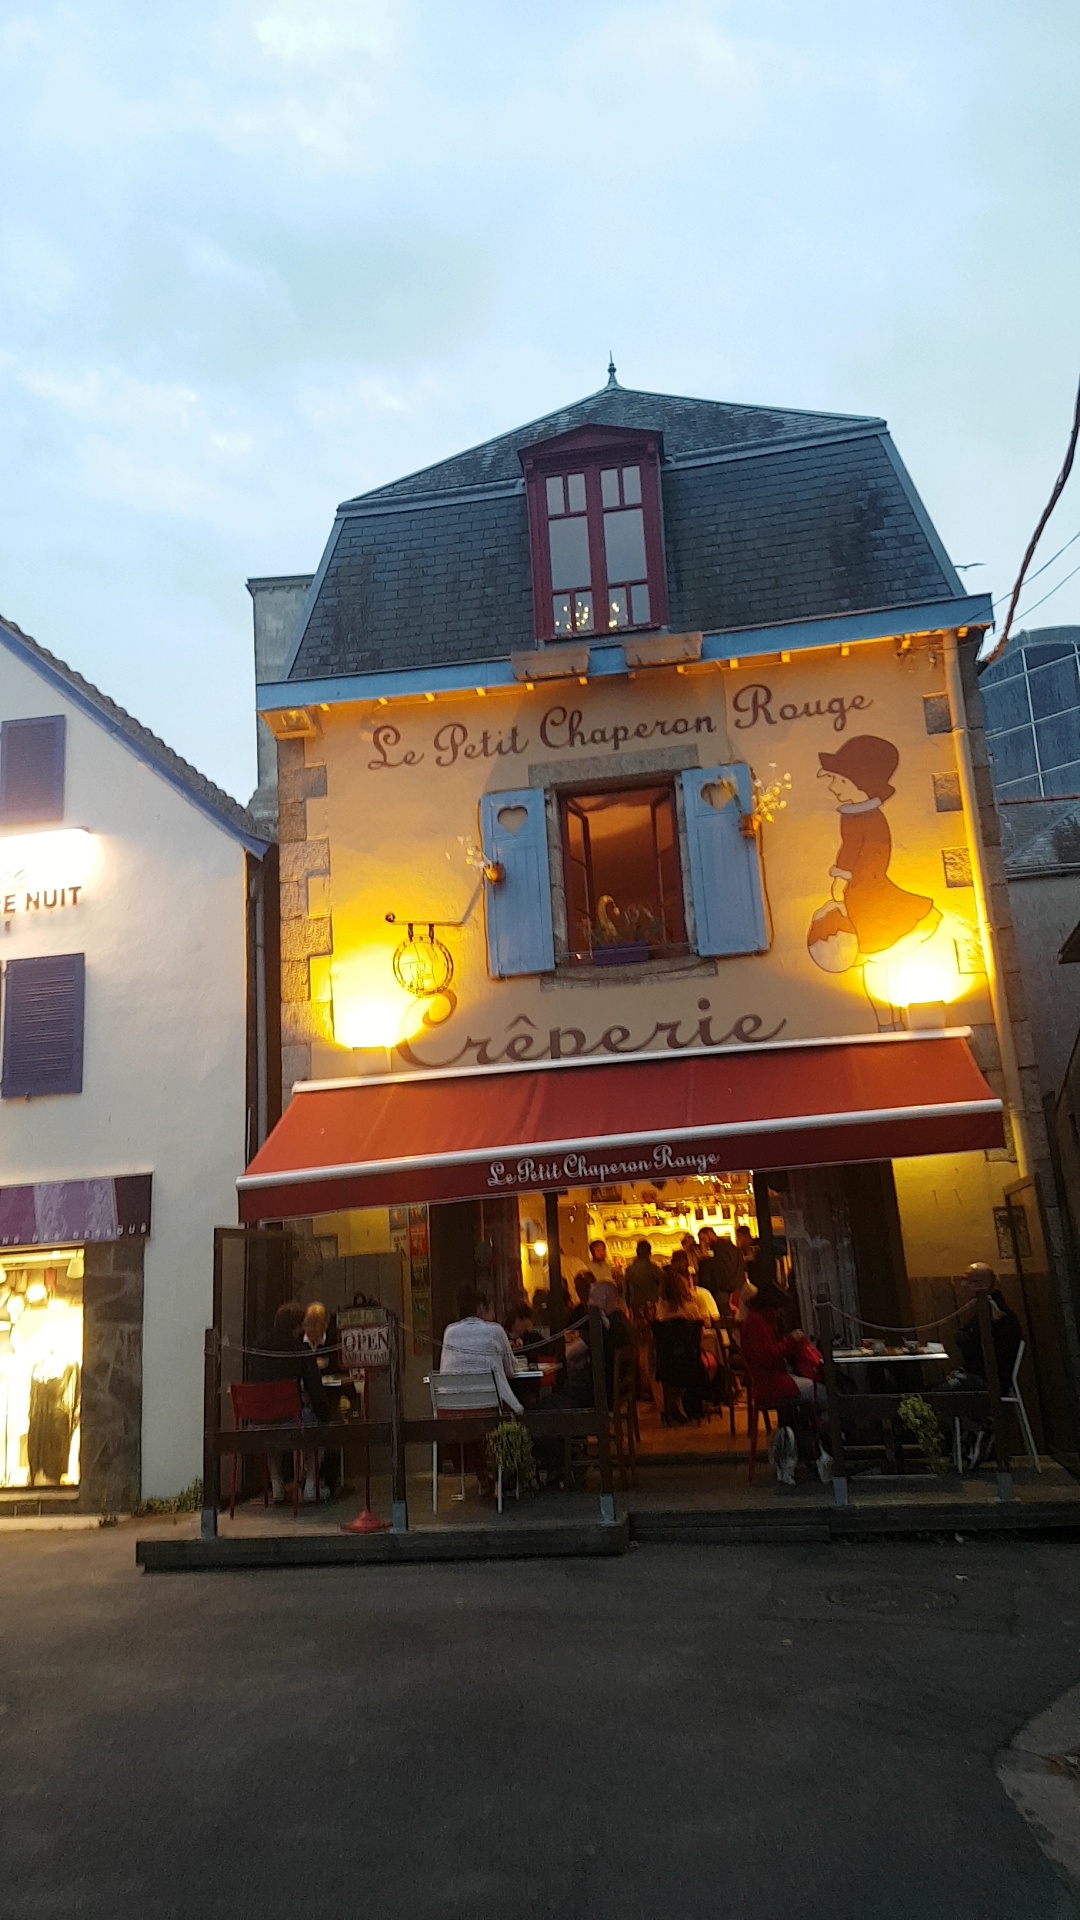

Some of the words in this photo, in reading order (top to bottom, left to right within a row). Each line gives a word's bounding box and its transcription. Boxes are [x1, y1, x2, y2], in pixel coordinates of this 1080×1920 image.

[367, 725, 424, 770] Le
[434, 723, 529, 767] Petit
[539, 706, 716, 751] Chaperon
[732, 683, 874, 732] Rouge
[0, 894, 16, 914] E
[26, 886, 82, 911] NUIT
[396, 988, 787, 1068] Crêperie
[487, 1161, 517, 1187] Le
[517, 1158, 562, 1183] Petit
[563, 1153, 652, 1182] Chaperon
[652, 1144, 720, 1174] Rouge
[344, 1331, 389, 1352] OPEN
